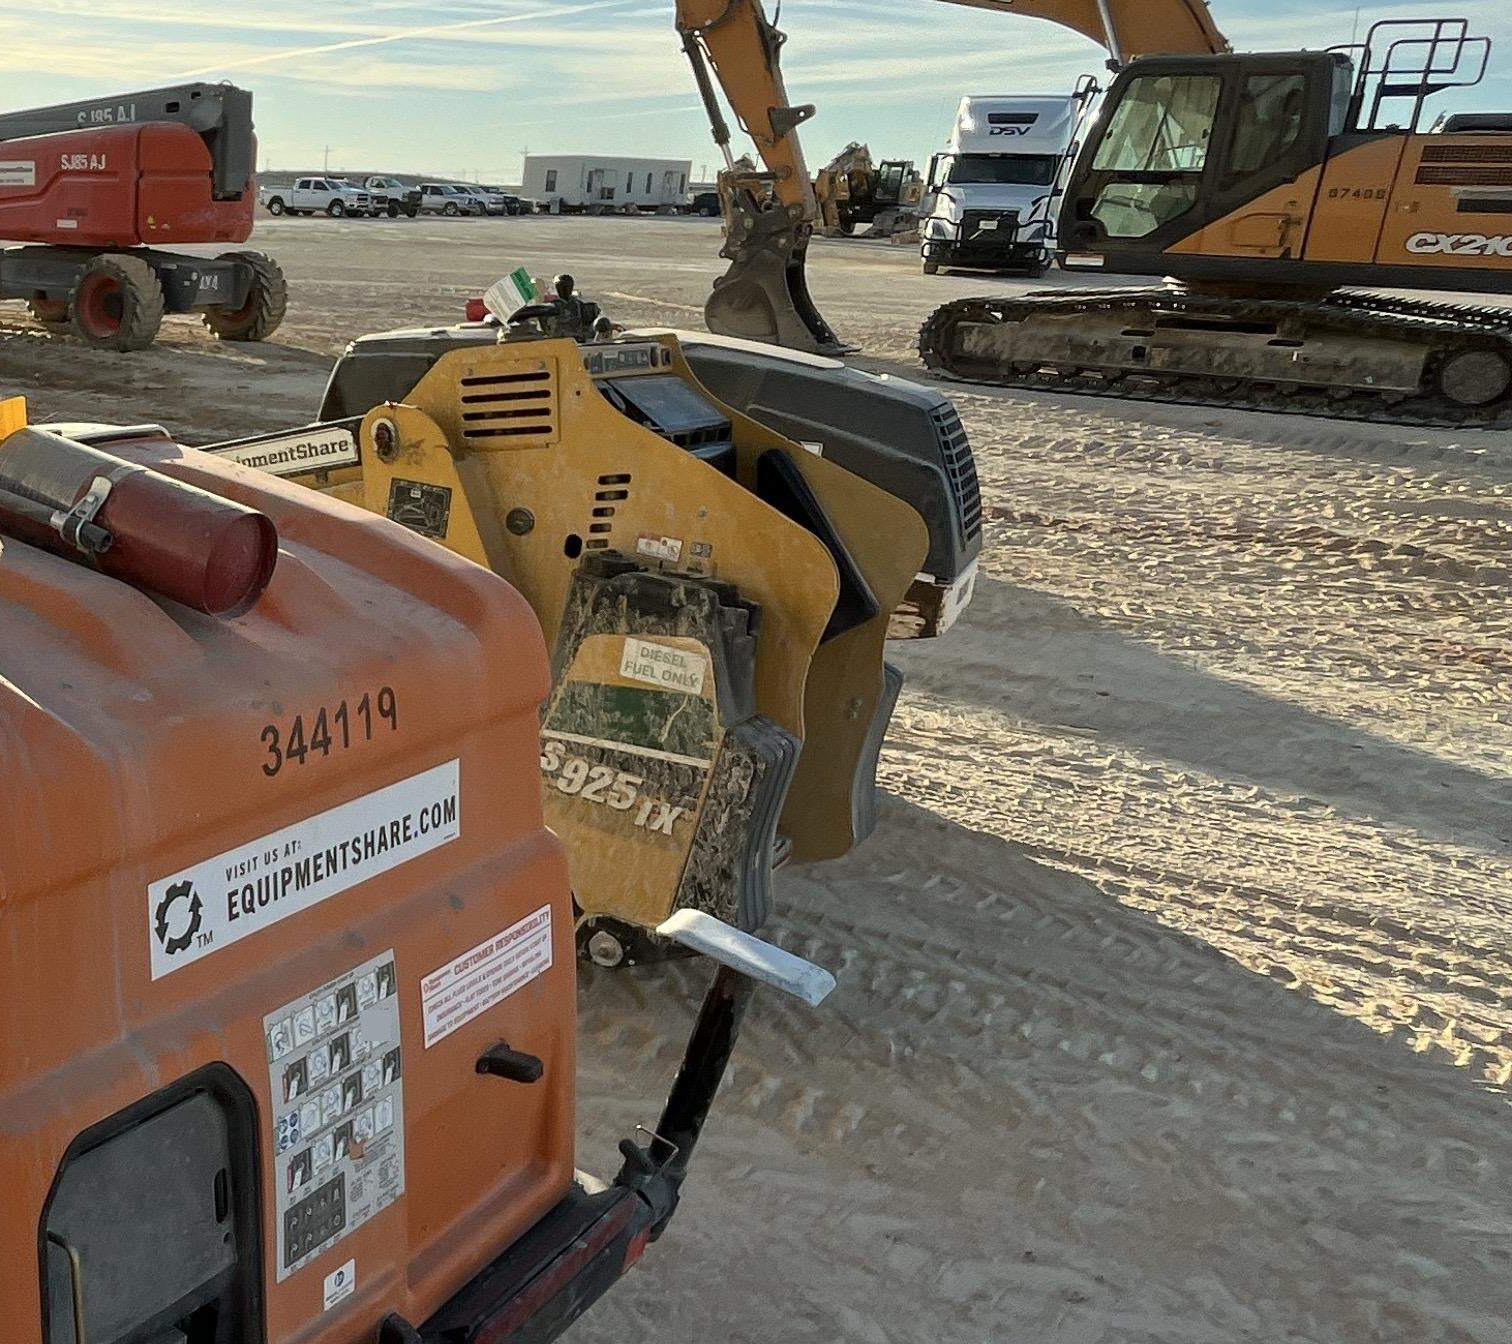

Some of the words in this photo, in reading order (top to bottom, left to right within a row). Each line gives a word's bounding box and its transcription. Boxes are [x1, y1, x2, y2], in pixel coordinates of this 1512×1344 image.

[989, 127, 1031, 136] DSV
[61, 155, 88, 171] SJ85
[89, 155, 106, 170] AJ
[235, 438, 350, 468] ipmentShare
[640, 646, 687, 669] DIESEL
[624, 660, 658, 680] FUEL
[661, 669, 699, 688] ONLY
[261, 686, 399, 777] 344119
[225, 856, 259, 882] VISIT
[264, 848, 279, 866] US
[227, 795, 456, 922] EQUIPMENTSHARE.COM
